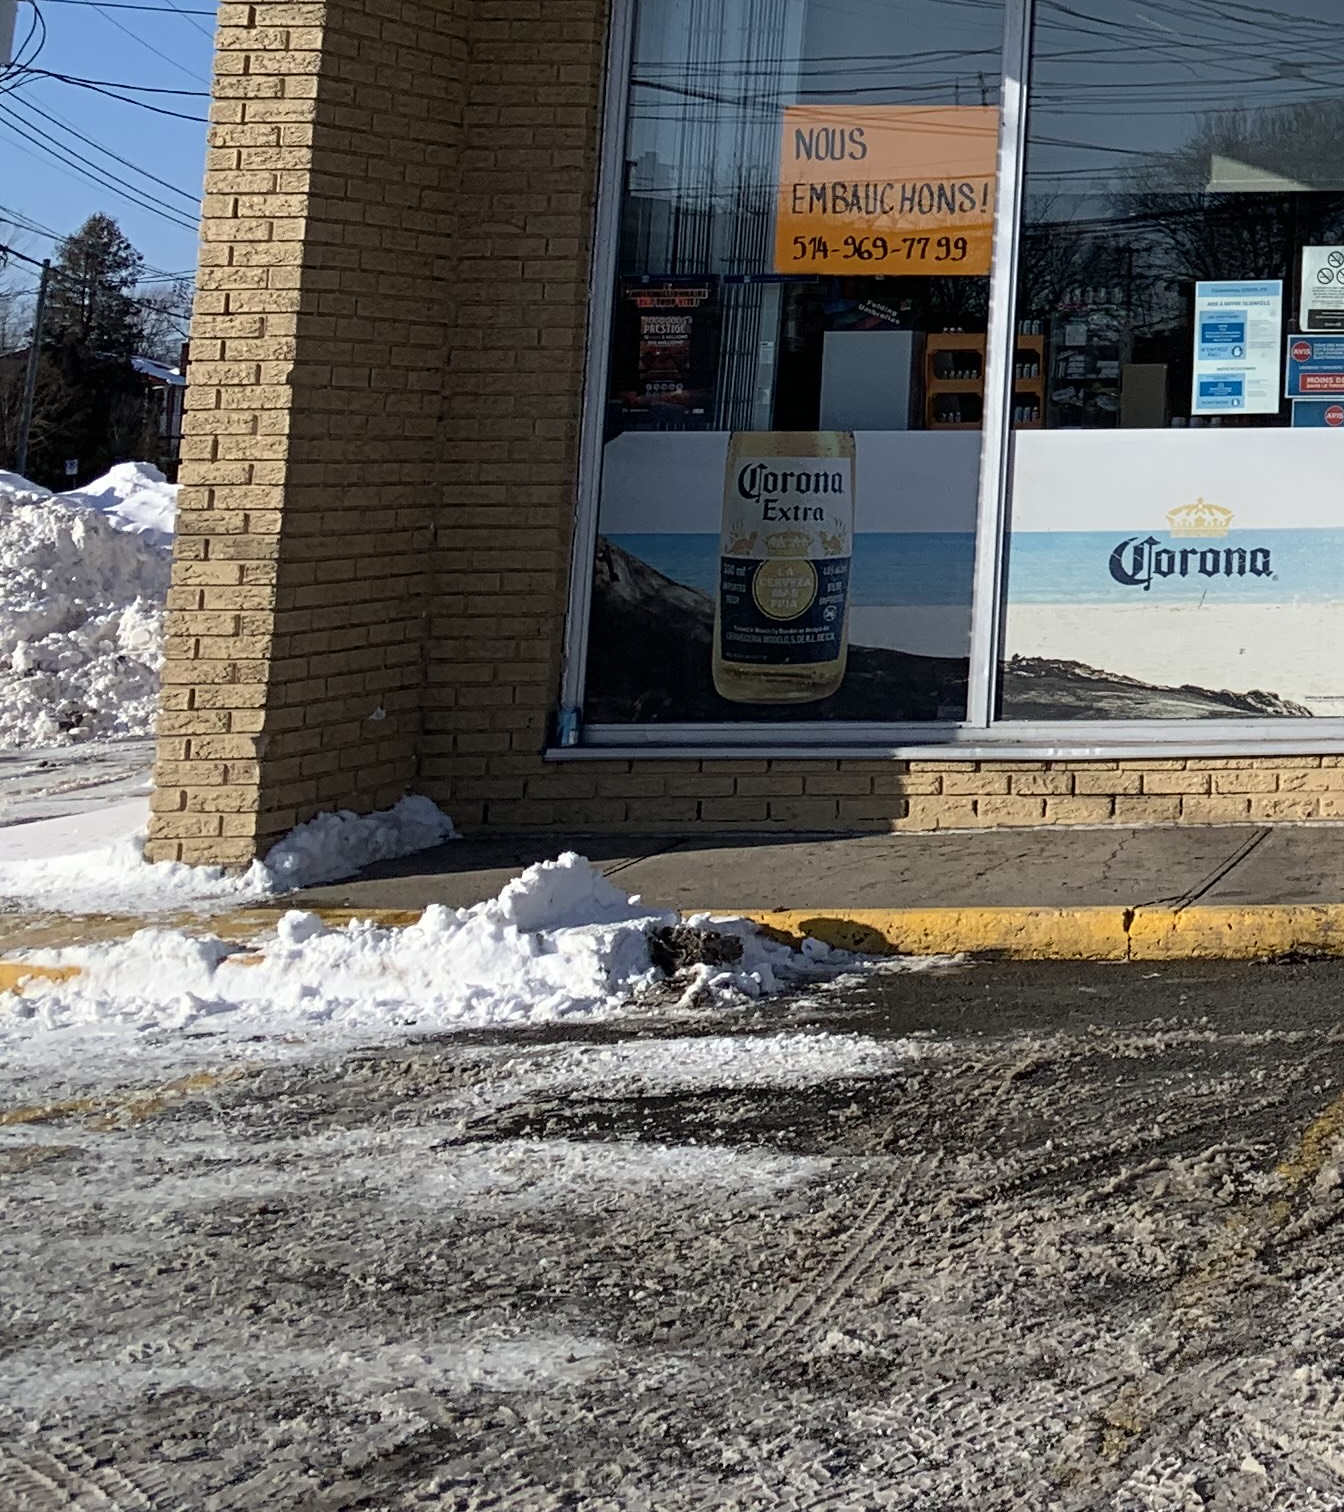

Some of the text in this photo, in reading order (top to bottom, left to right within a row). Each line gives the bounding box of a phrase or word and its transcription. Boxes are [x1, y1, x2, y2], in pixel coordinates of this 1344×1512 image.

[794, 127, 868, 161] NOUS
[791, 181, 989, 216] EMBAUCHONS!
[792, 235, 968, 262] 514-969-7799
[1306, 376, 1334, 384] MOINS
[738, 463, 845, 504] Corona
[762, 498, 825, 522] Extra
[777, 567, 794, 577] LA
[1108, 535, 1274, 591] Corona
